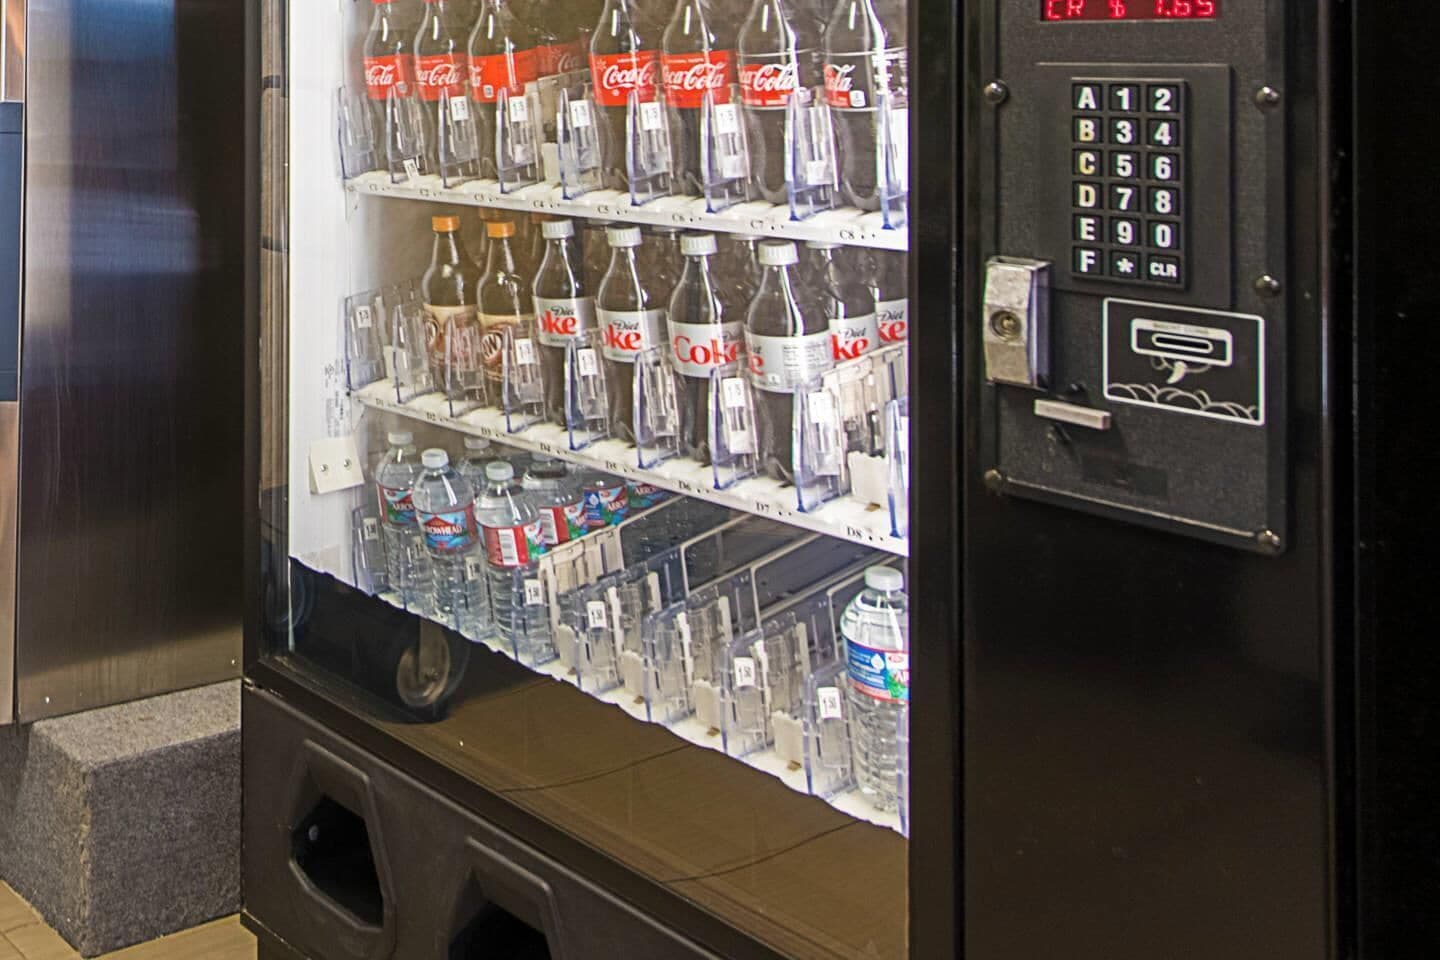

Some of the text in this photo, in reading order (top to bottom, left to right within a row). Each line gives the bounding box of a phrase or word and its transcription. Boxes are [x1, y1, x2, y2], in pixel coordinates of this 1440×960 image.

[1078, 87, 1172, 111] A 1 2
[1078, 120, 1172, 145] B 3 4
[1078, 153, 1172, 180] C 5 6
[598, 206, 609, 214] C5
[1078, 185, 1172, 213] D 7 8
[750, 220, 764, 230] C7
[839, 230, 854, 240] C8
[1078, 218, 1172, 248] E 9 0
[1079, 250, 1177, 279] F CLR
[537, 309, 577, 336] ke
[612, 319, 640, 330] Diet
[881, 309, 905, 321] Diet
[603, 323, 642, 350] ke
[843, 327, 867, 338] Diet
[877, 321, 907, 342] ke
[831, 334, 869, 361] ke
[756, 502, 770, 513] D7
[846, 525, 861, 537] D8
